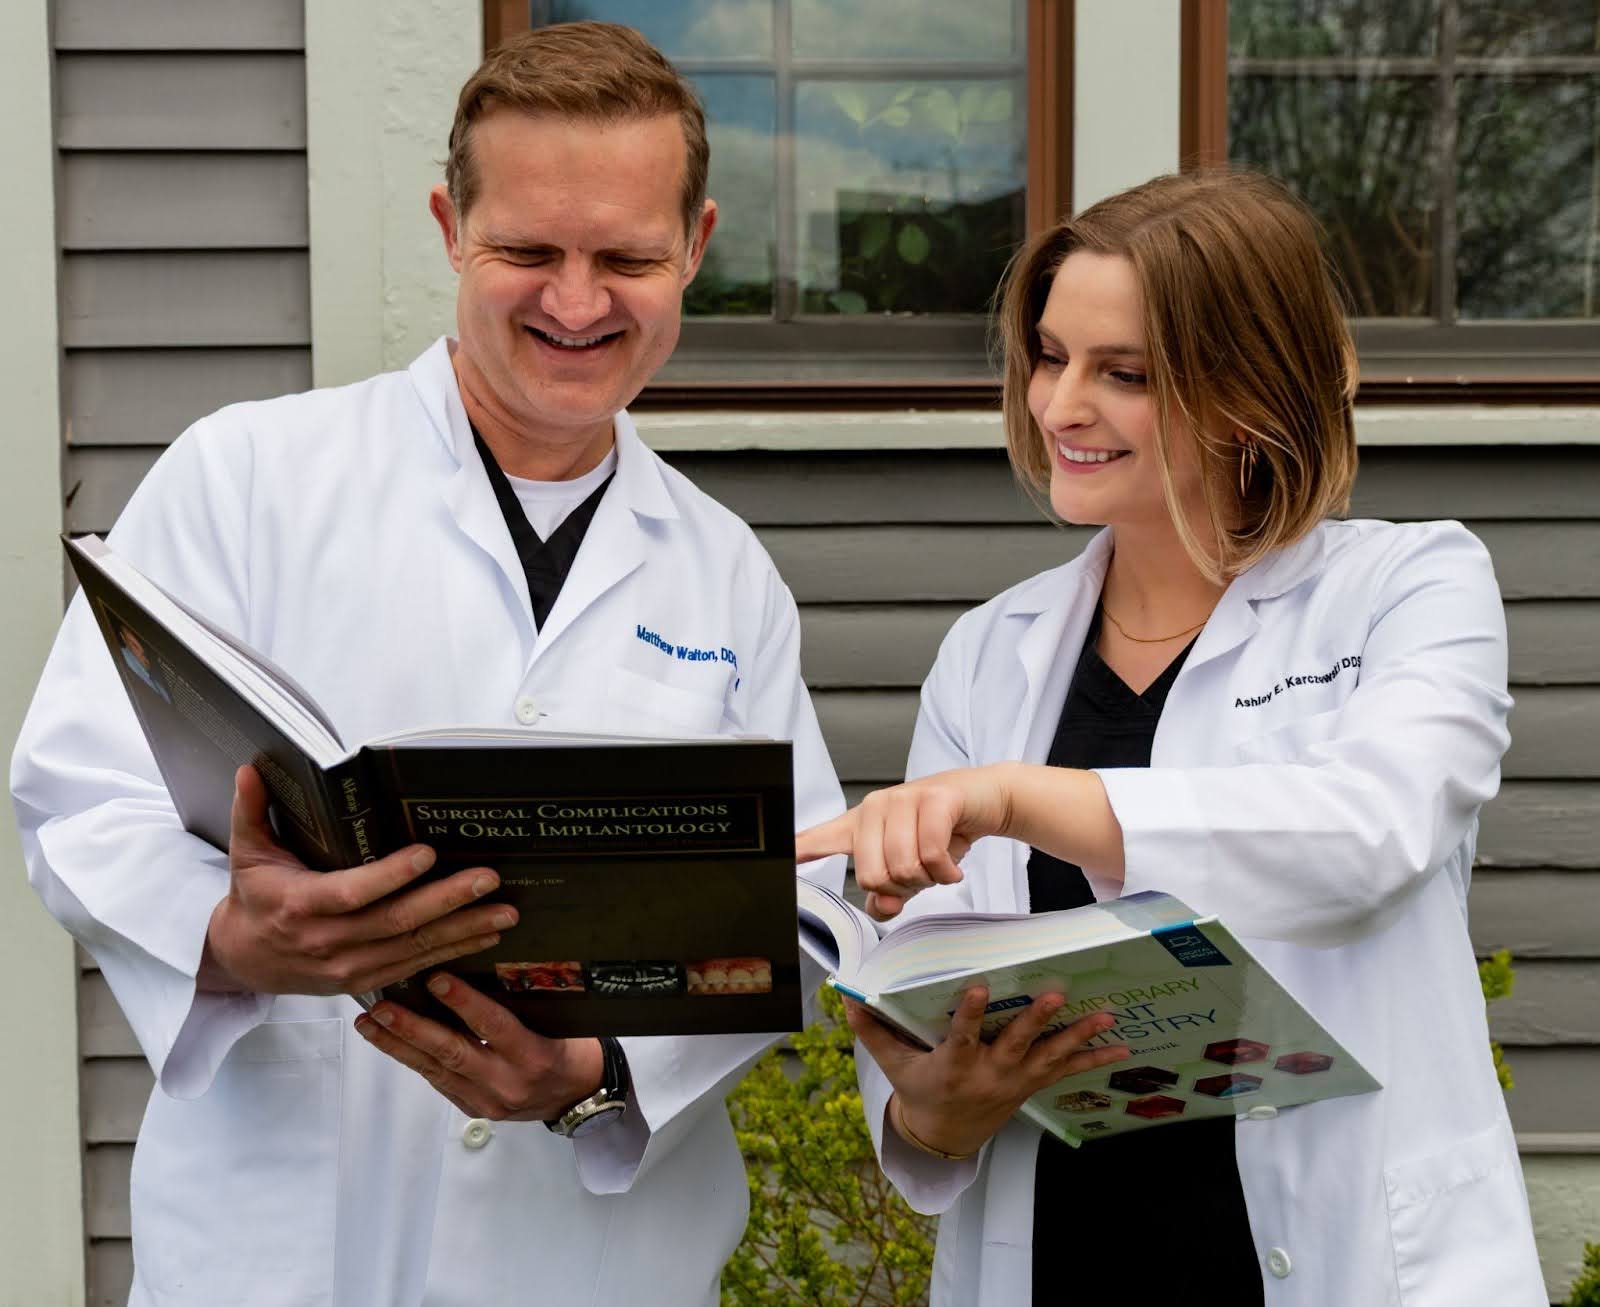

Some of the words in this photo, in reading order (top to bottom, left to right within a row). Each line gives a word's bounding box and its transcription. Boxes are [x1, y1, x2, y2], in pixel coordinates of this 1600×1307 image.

[637, 624, 674, 656] Matthew
[676, 646, 718, 662] Walton,
[1235, 691, 1272, 708] Ashley
[1274, 684, 1284, 695] E.
[416, 805, 531, 820] SURGICAL
[537, 803, 728, 819] COMPLICATIONS
[427, 825, 448, 834] IN
[458, 822, 532, 838] ORAL
[537, 820, 732, 837] IMPLANTOLOGY
